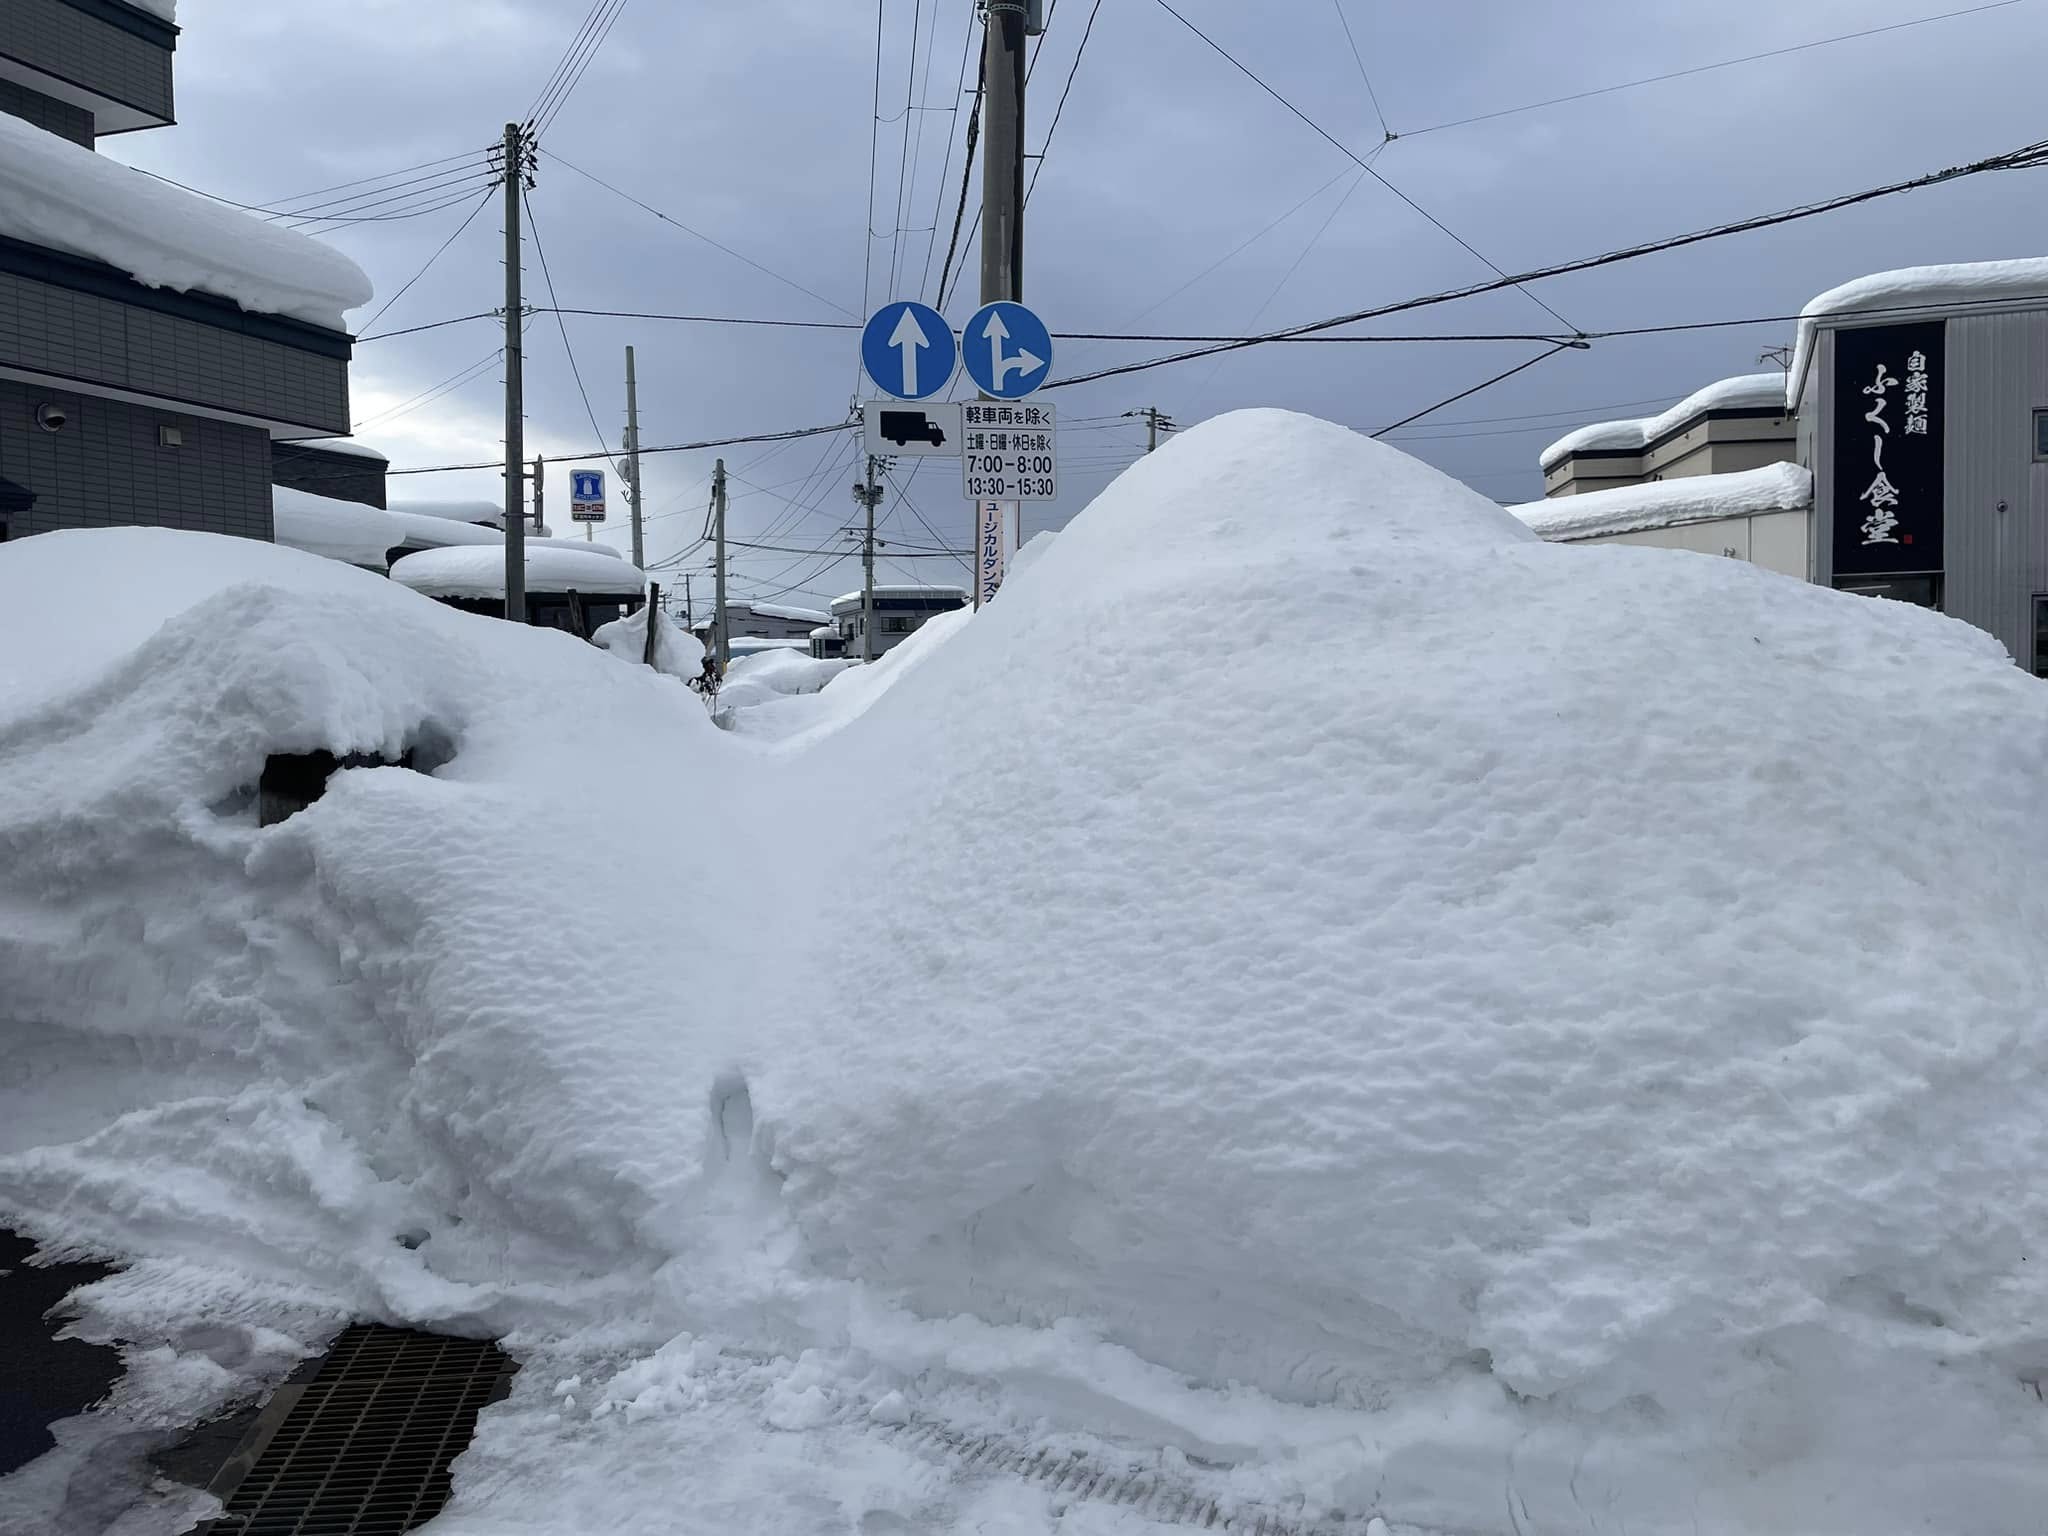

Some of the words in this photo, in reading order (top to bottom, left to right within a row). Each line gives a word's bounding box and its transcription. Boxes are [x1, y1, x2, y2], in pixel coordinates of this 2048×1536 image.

[966, 406, 1051, 425] 軽車両を除く
[1904, 350, 1929, 435] 自家製麺
[967, 433, 1052, 452] 土曜・日曜・休日を除く
[1859, 363, 1900, 546] ふくし食堂
